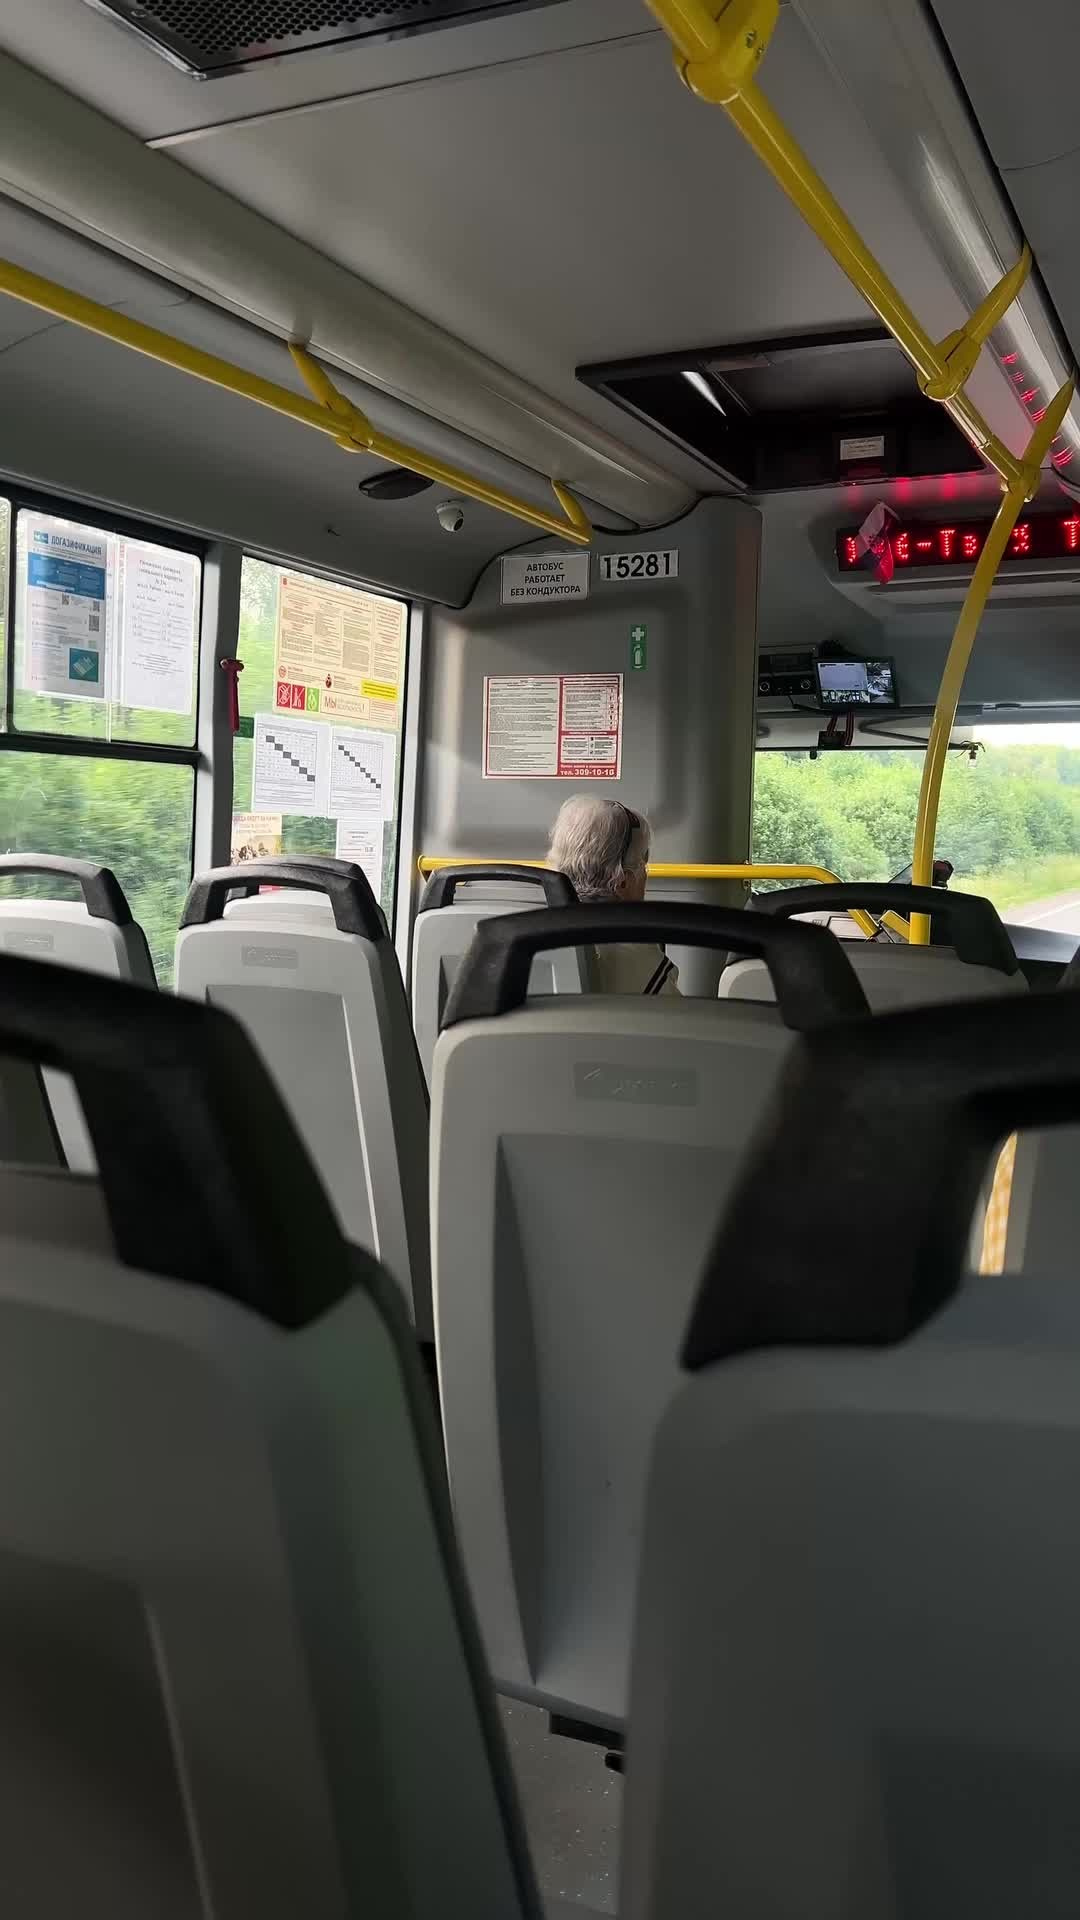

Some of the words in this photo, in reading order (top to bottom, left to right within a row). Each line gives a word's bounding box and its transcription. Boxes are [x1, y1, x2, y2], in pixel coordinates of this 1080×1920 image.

[526, 561, 565, 572] АВТОБУС
[603, 552, 671, 579] 15281
[524, 573, 566, 584] РАБОТАЕТ
[510, 587, 525, 597] БЕЗ
[526, 585, 581, 596] КОНДУКТОРА
